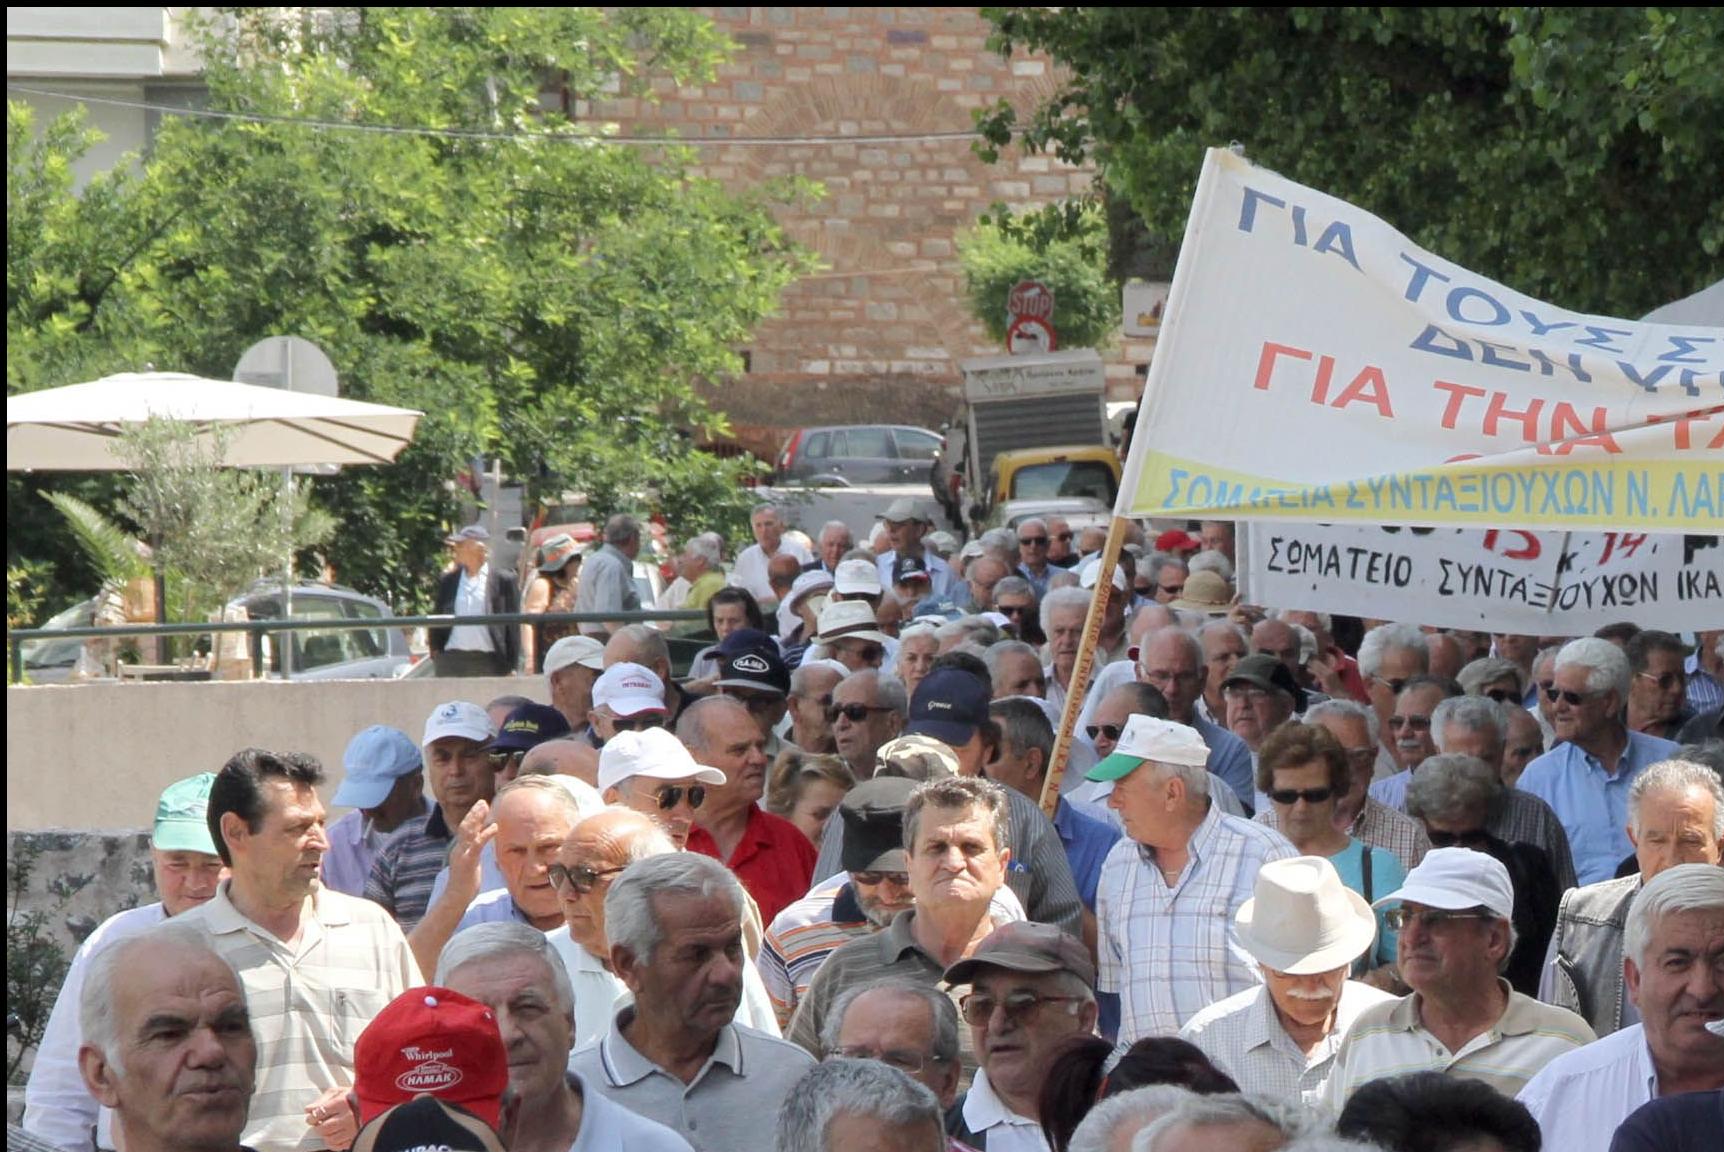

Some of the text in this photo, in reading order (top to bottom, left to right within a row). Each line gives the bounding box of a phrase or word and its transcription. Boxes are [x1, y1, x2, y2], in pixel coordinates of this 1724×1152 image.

[1238, 186, 1366, 275] ΓΙΑ
[1400, 251, 1633, 353] ΤΟΥΣ
[1010, 293, 1051, 316] STOP
[1409, 323, 1592, 383] ΔΕΝ
[1253, 341, 1394, 418] ΓΙΑ
[1433, 380, 1608, 445] ΤΗΝ
[1345, 470, 1613, 517] ΣΥΝΤΑΞΙΟΥΧΩΝ
[1267, 537, 1412, 588] ΣΩΜΑΤΕΙΟ
[1438, 558, 1658, 611] ΣΥΝΤΑΞΙΟΥΧΩΝ
[402, 1047, 453, 1062] Whirlpool
